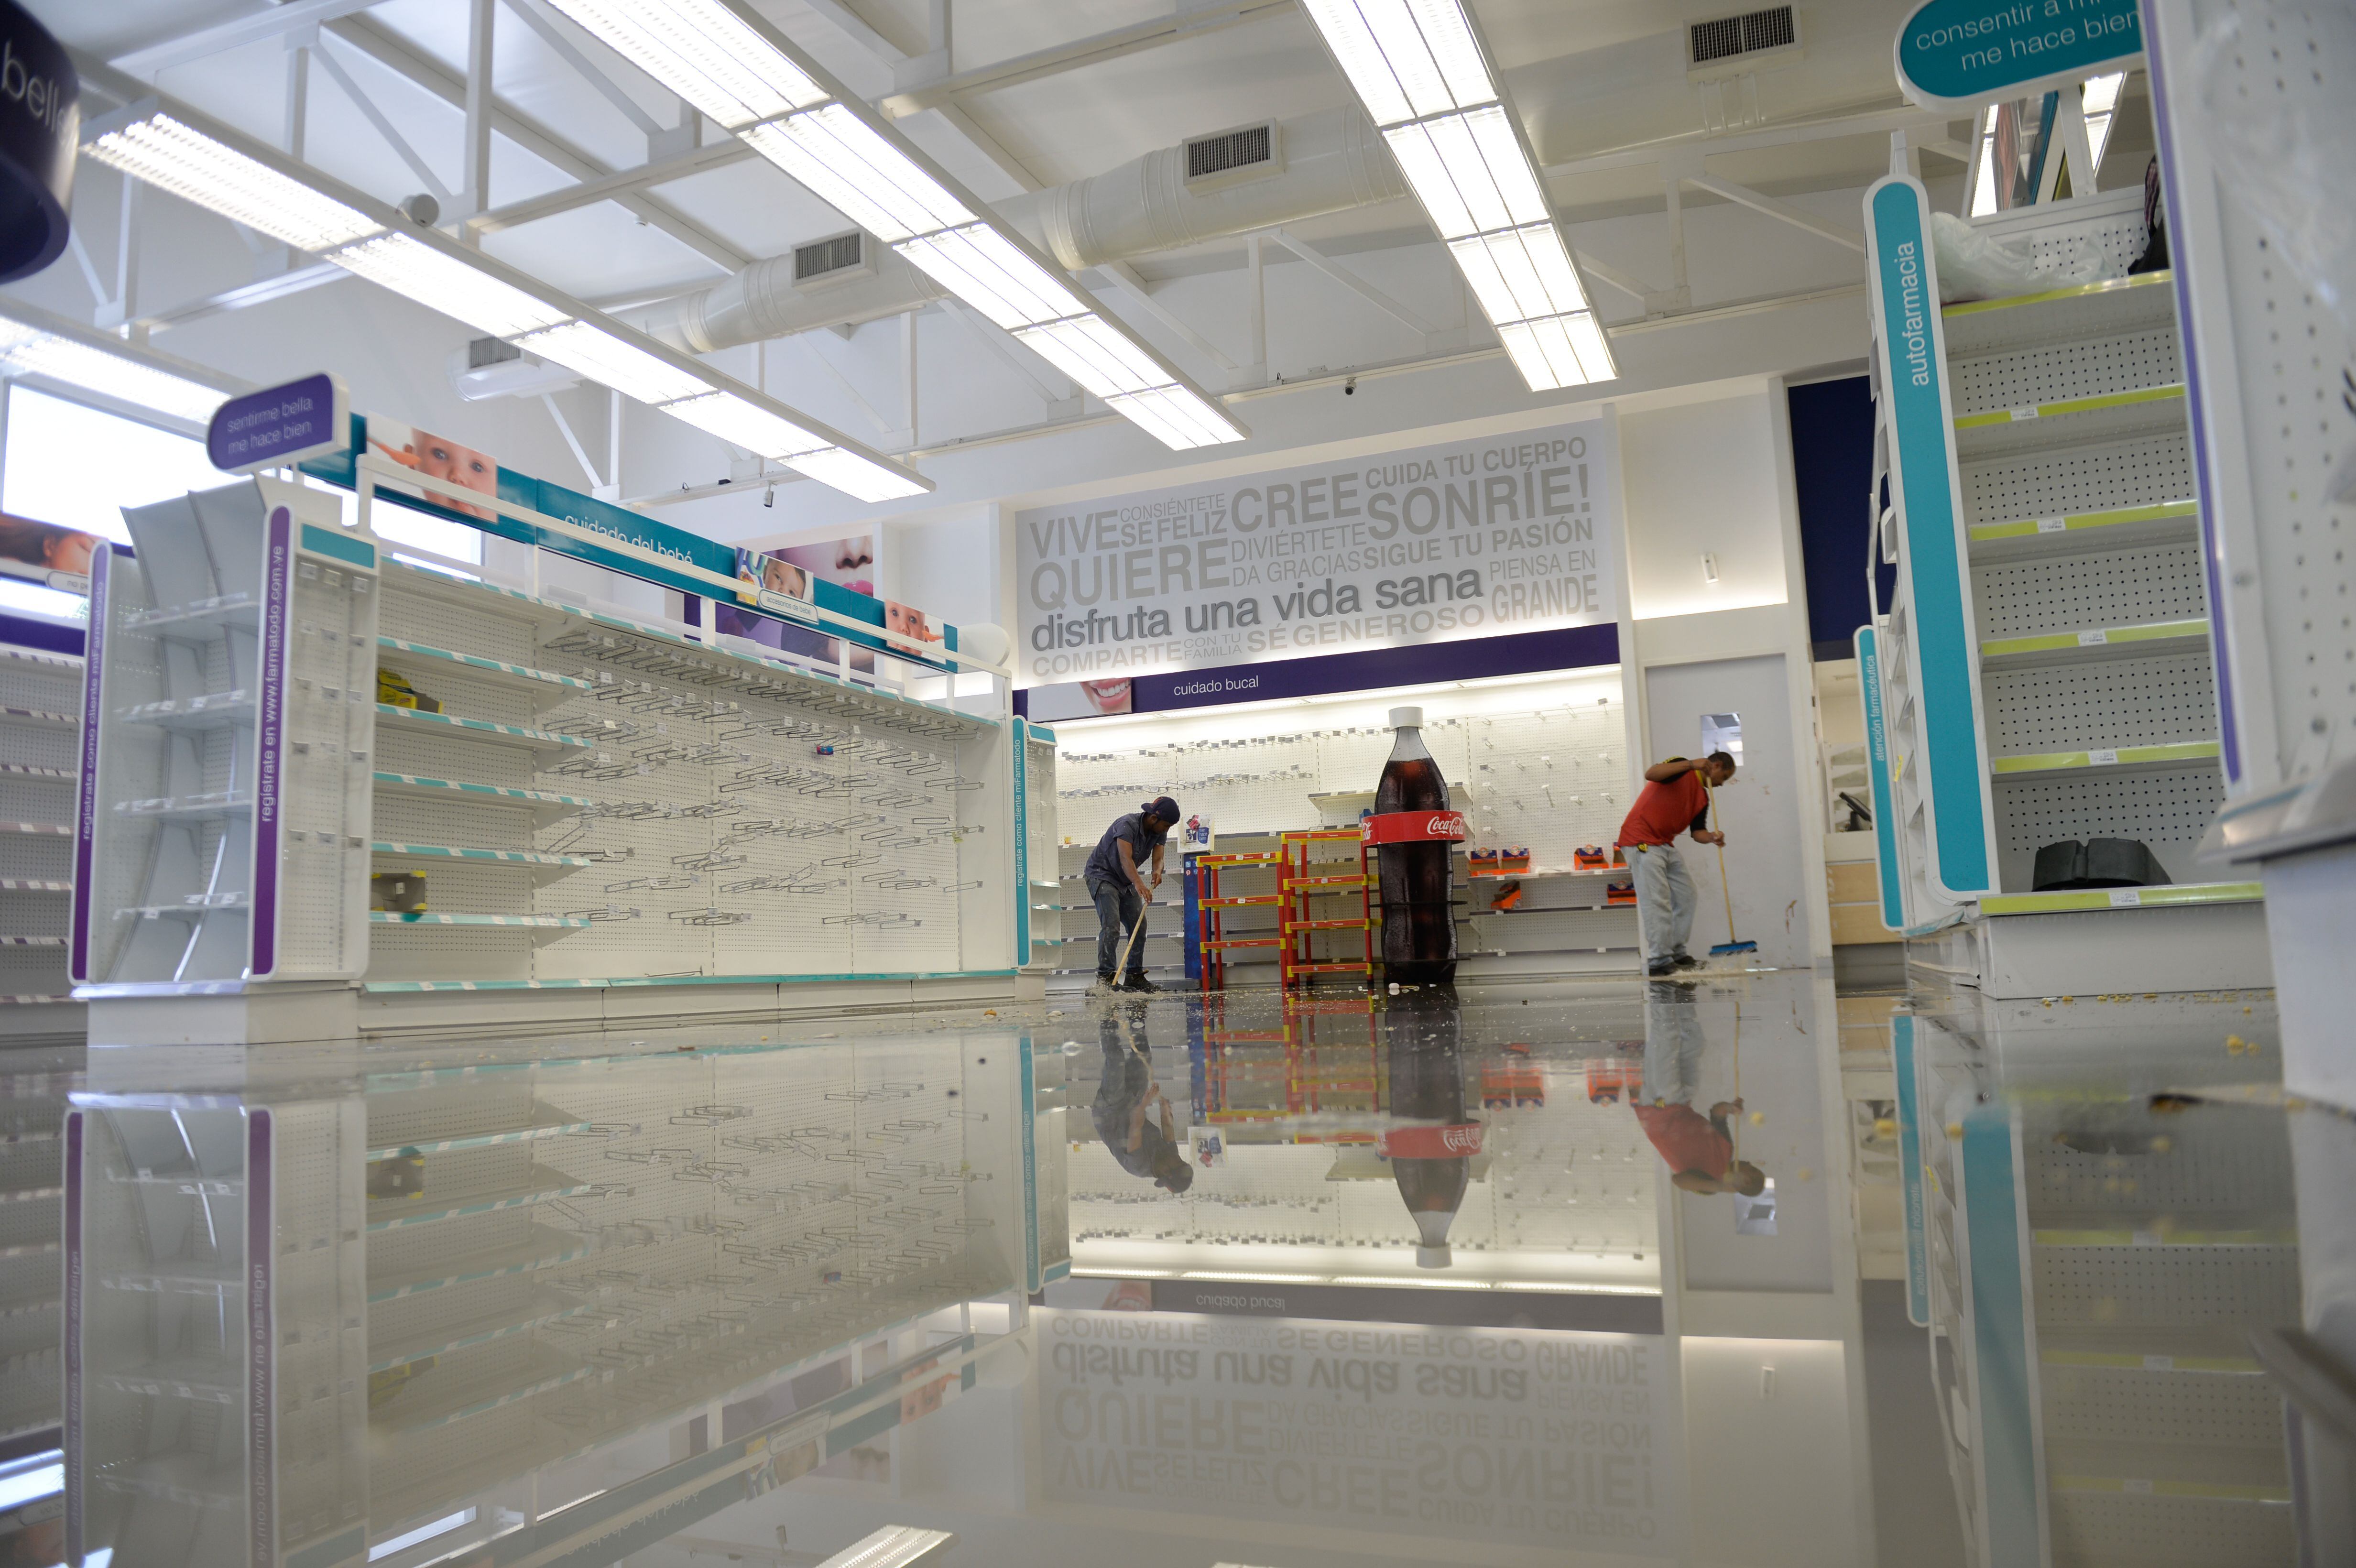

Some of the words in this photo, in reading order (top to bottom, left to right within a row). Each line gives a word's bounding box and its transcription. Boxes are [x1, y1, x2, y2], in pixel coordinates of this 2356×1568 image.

[1916, 1, 2034, 50] consentir
[1961, 47, 2002, 71] me
[2011, 28, 2076, 58] hace
[1894, 240, 1929, 386] autofarmacia
[227, 408, 280, 433] sentirme
[282, 397, 313, 417] bella
[228, 439, 249, 454] me
[250, 429, 282, 448] hace
[284, 421, 312, 439] bien
[1365, 460, 1438, 489] CUIDA
[1444, 454, 1474, 477] TU
[1483, 437, 1586, 471] CUERPO
[1120, 493, 1224, 522] CONSIÉNTETE
[1231, 473, 1361, 533] CREE
[1367, 462, 1590, 540] SONRÍE!
[1030, 510, 1119, 559] VIVE
[1157, 510, 1227, 542] FELIZ
[1232, 522, 1366, 563] DIVIÉRTETE
[1364, 539, 1442, 570] SIGUE
[1449, 533, 1482, 557] TU
[1492, 516, 1593, 553] PASIÓN
[1031, 538, 1229, 611] QUIERE
[1233, 566, 1259, 587] DA
[1267, 551, 1361, 582] GRACIAS
[1490, 554, 1563, 581] PIENSA
[1568, 549, 1595, 571] EN
[767, 597, 792, 609] accesorios
[799, 605, 810, 615] bebé
[1032, 606, 1171, 651] disfruta
[1185, 598, 1260, 632] una
[1273, 578, 1362, 621] vida
[1375, 569, 1484, 609] sana
[1492, 574, 1599, 623] GRANDE
[91, 581, 104, 675] miFarmatodo
[266, 545, 284, 723] www.farmatodo.com.ve
[1183, 636, 1218, 648] CON
[1221, 633, 1241, 644] TU
[1247, 623, 1287, 653] SÉ
[1293, 604, 1484, 647] GENEROSO
[1033, 641, 1181, 676] COMPARTE
[1184, 644, 1242, 659] FAMILIA
[89, 677, 100, 723] cliente
[1174, 681, 1222, 696] cuidado
[1226, 675, 1258, 690] bucal
[1866, 655, 1880, 717] farmacéutica
[265, 727, 276, 746] en
[1872, 719, 1885, 762] atención
